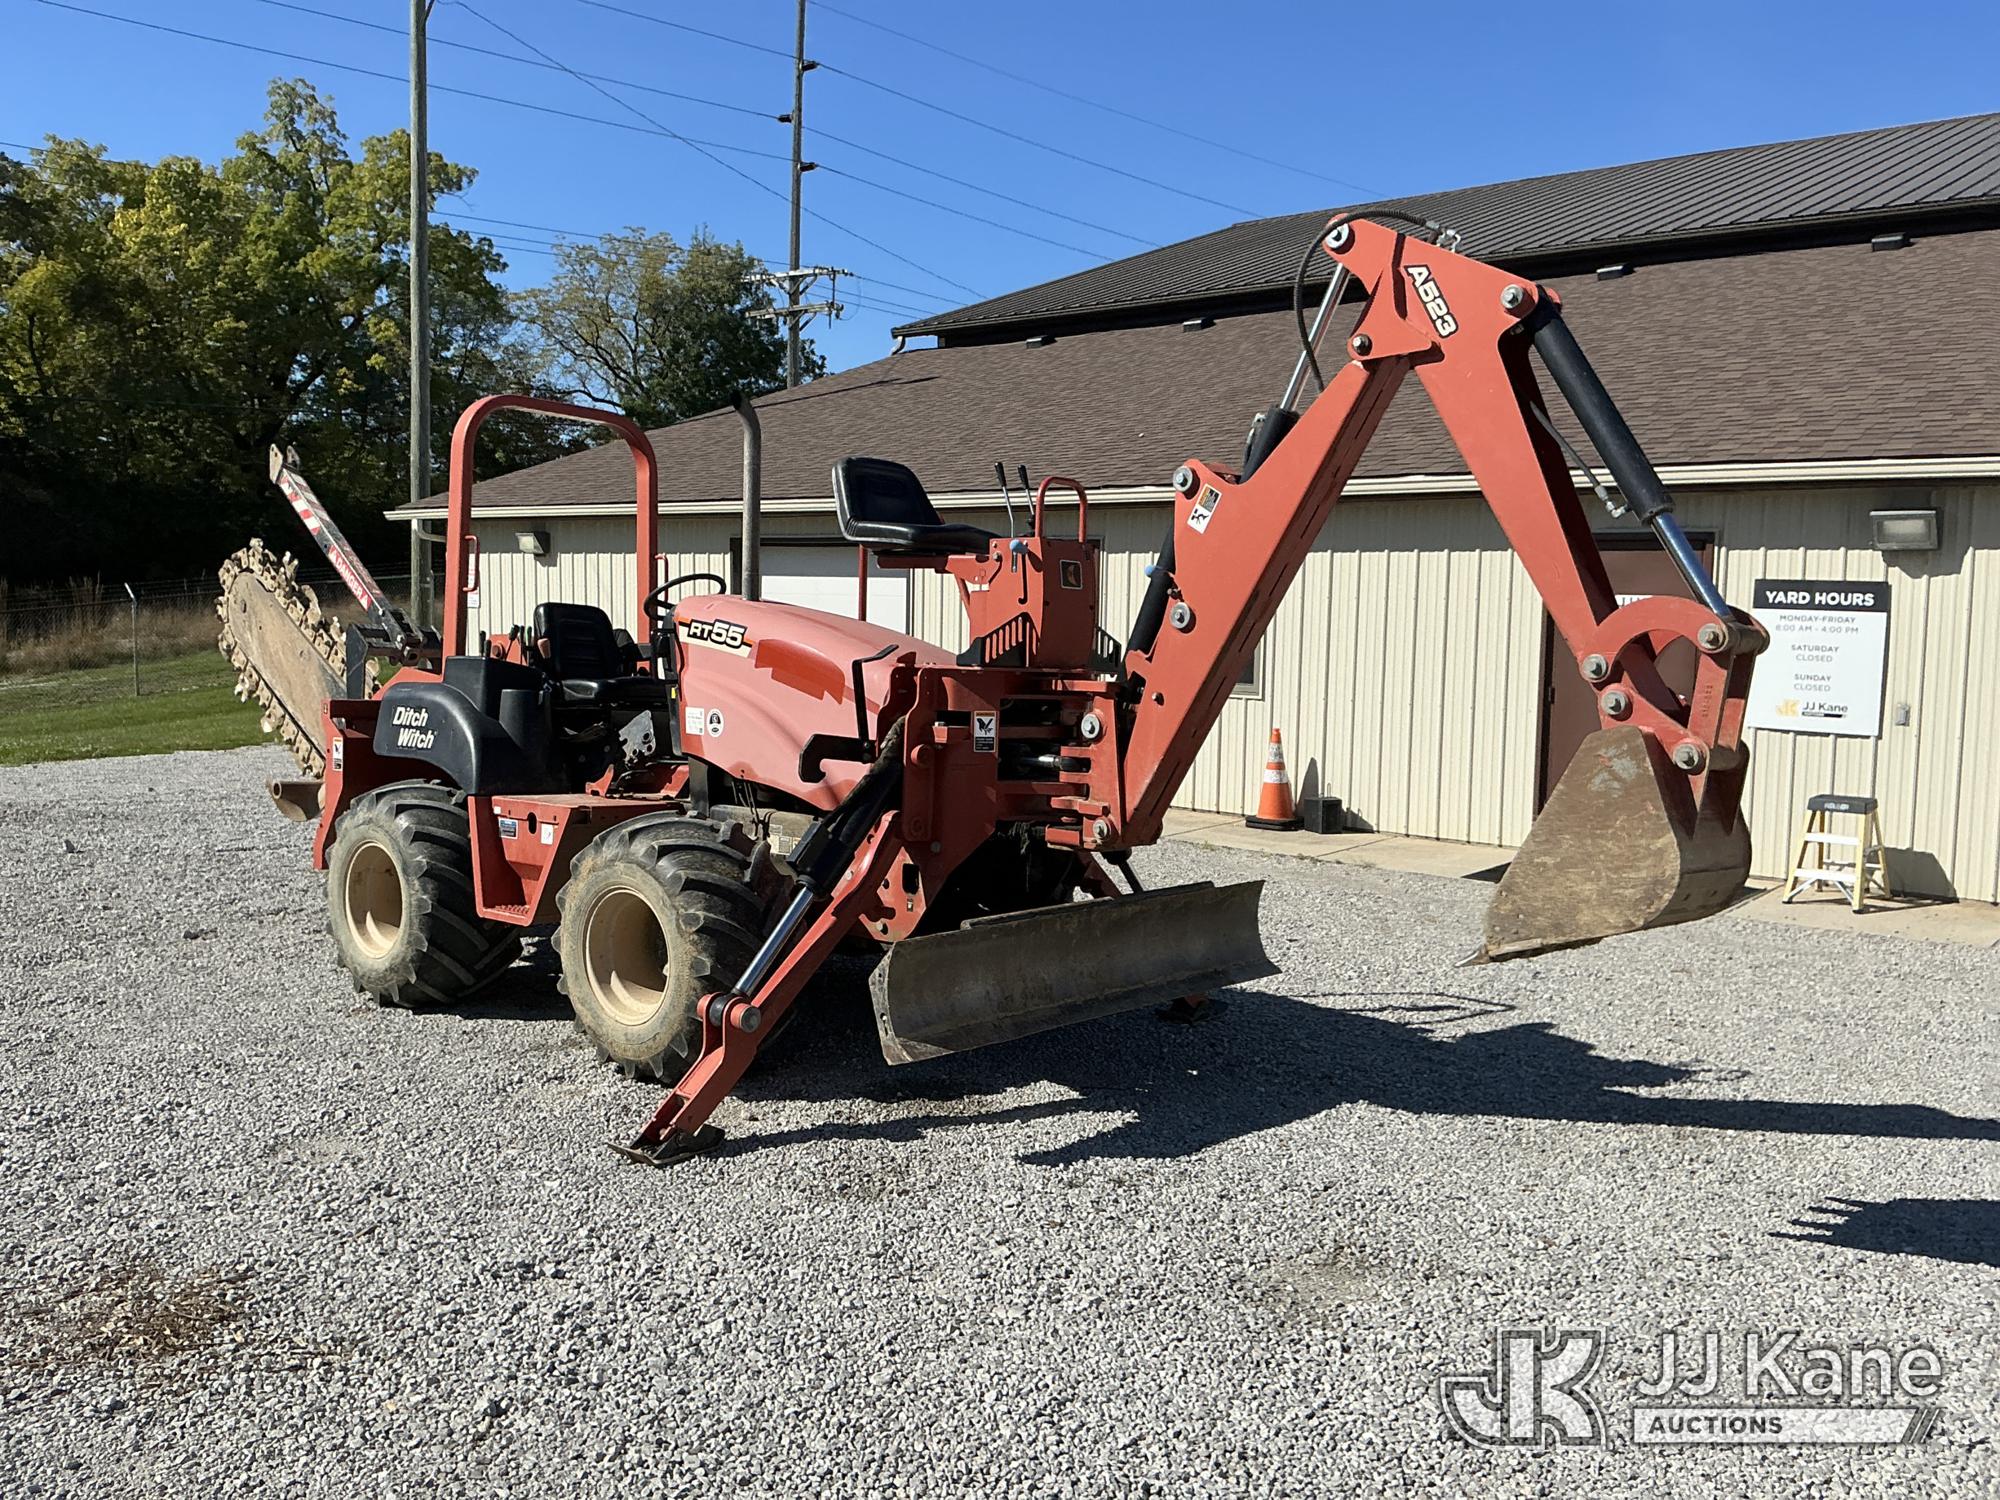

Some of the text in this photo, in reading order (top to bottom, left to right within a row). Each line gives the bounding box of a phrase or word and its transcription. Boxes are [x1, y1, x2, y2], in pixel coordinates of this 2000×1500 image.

[1406, 266, 1458, 337] A523
[336, 556, 364, 600] DANGER
[1765, 590, 1875, 607] YARD HOURS
[1779, 614, 1856, 624] MONDAY-FRIDAY
[689, 621, 745, 647] RT55
[1799, 625, 1813, 633] AM
[1822, 626, 1842, 634] 4:00
[1845, 626, 1859, 634] PM
[1791, 643, 1840, 653] SATURDAY
[1795, 653, 1833, 663] CLOSED
[1794, 673, 1832, 682] SUNDAY
[1793, 683, 1831, 692] CLOSED
[1803, 701, 1848, 713] JJ Kane
[392, 706, 429, 727] Ditch
[397, 727, 435, 749] Witch
